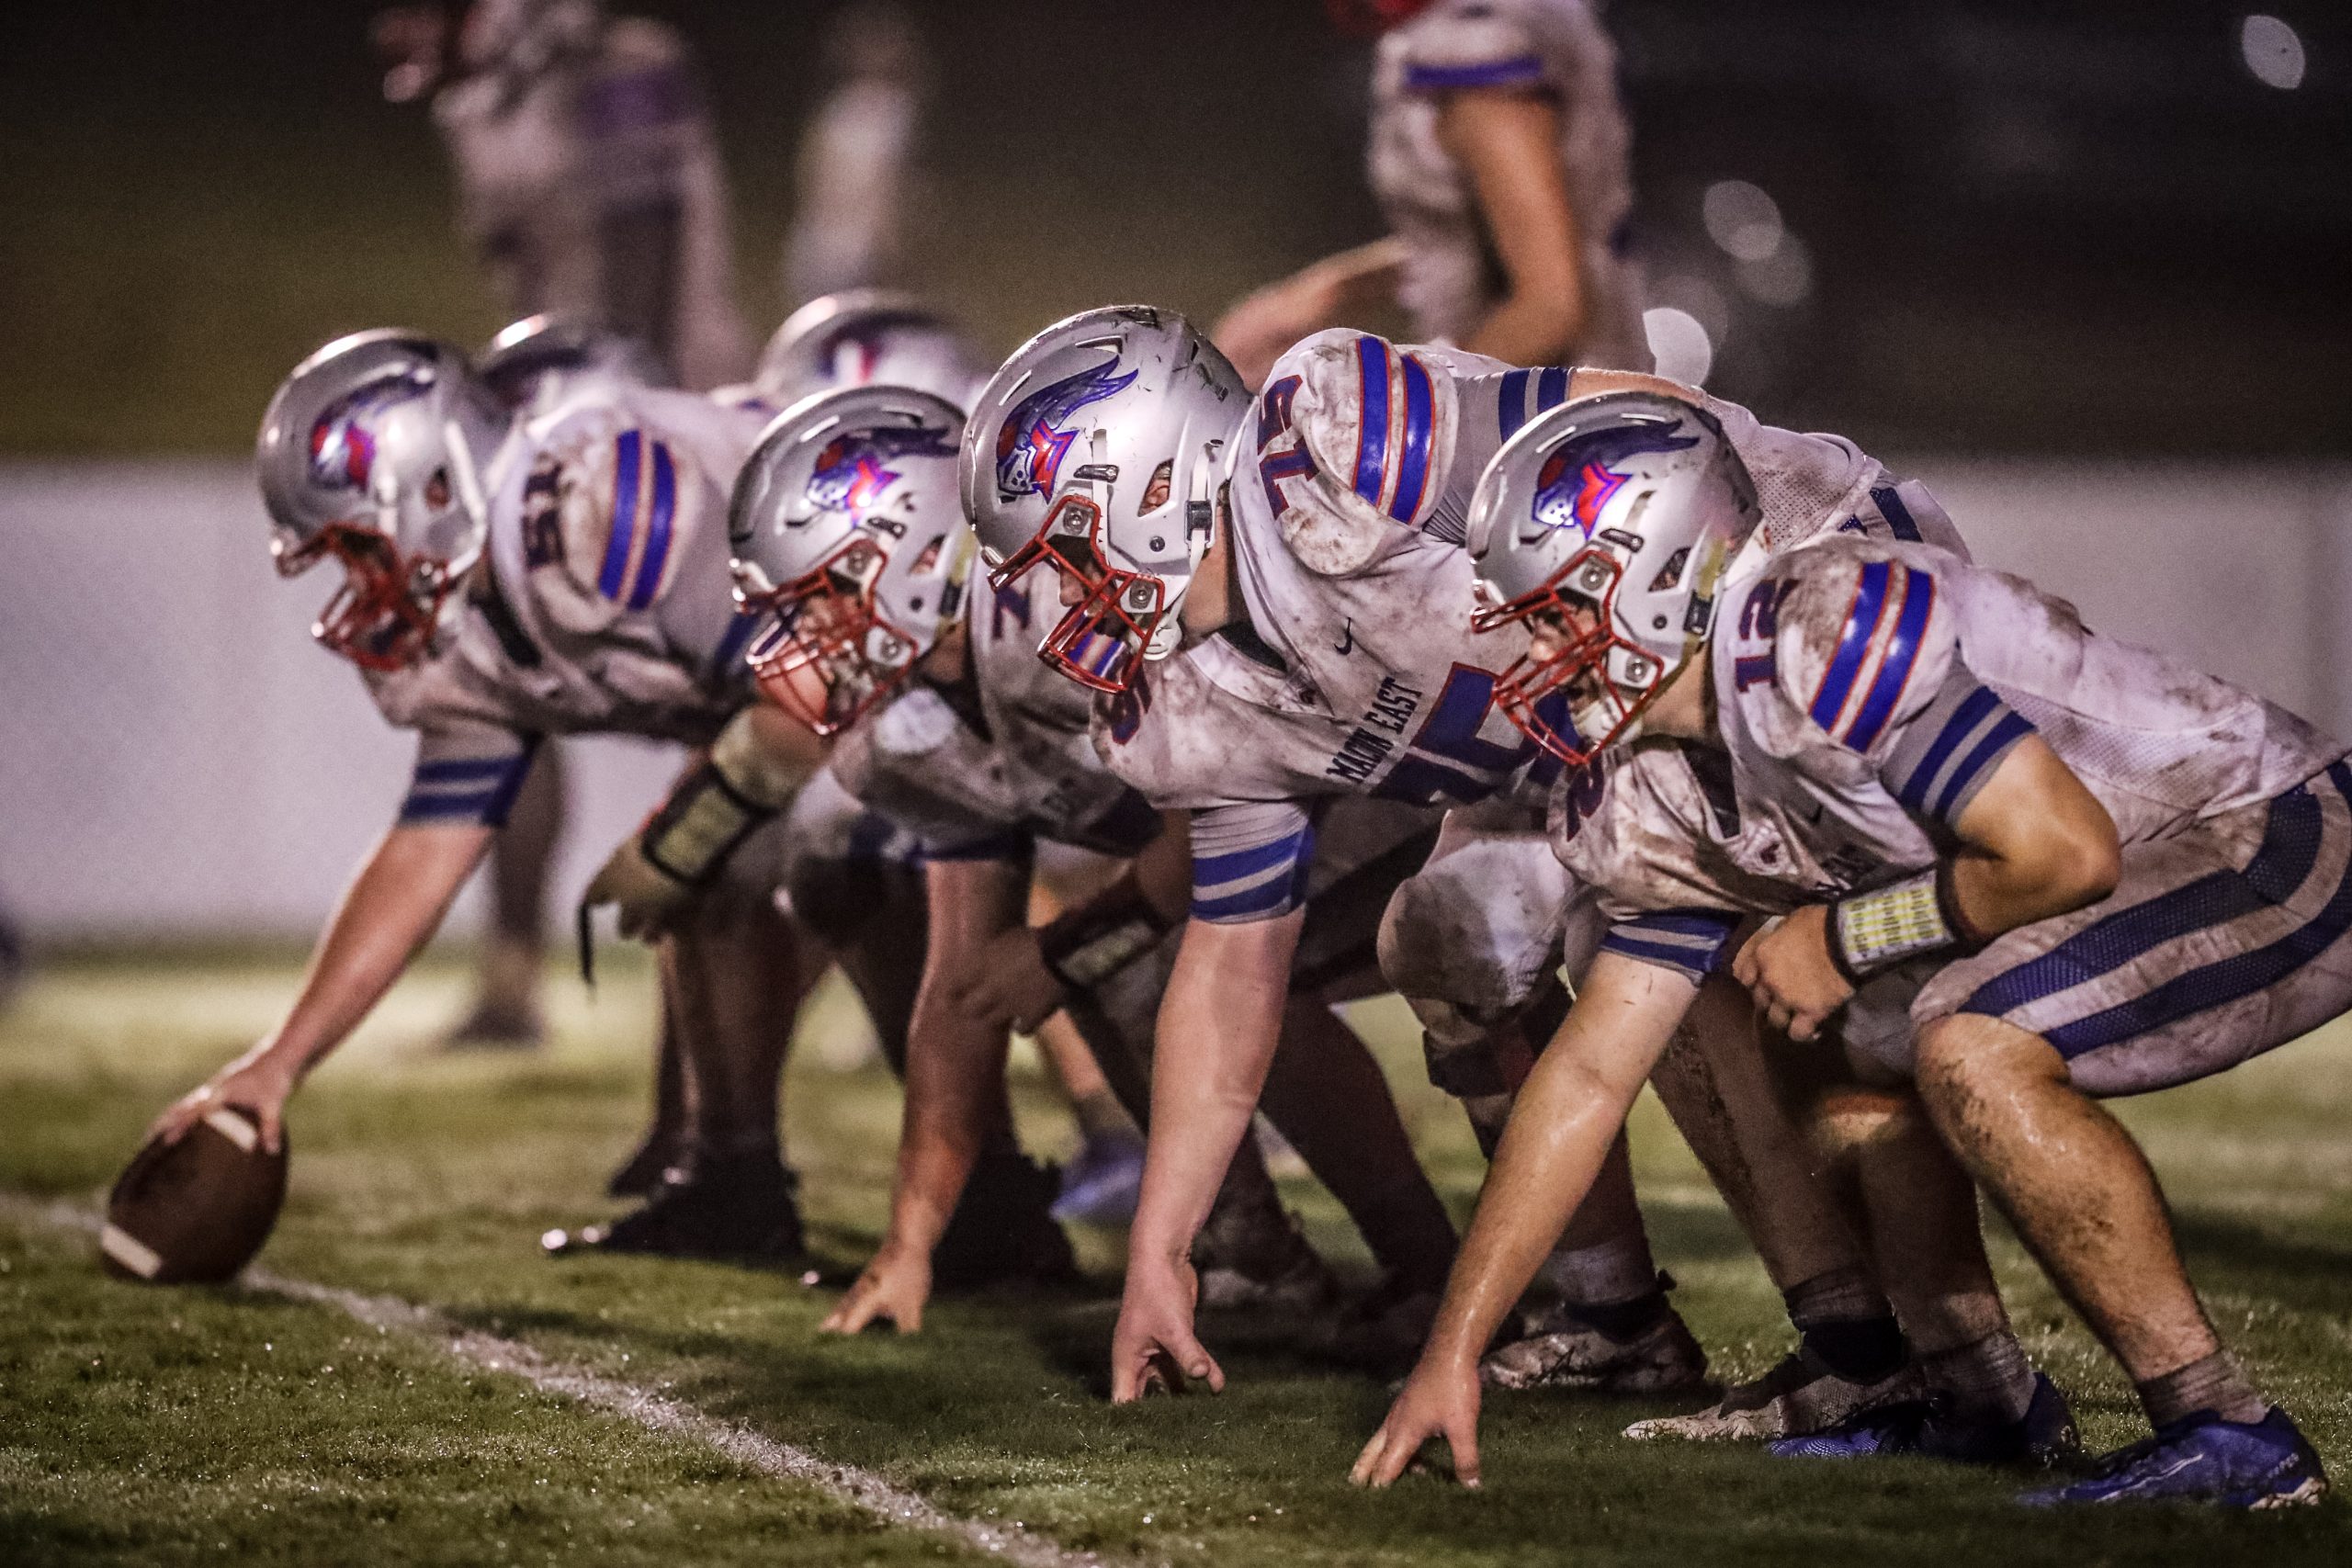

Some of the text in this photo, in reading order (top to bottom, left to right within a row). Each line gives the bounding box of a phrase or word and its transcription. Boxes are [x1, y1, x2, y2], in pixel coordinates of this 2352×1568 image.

[1258, 375, 1320, 520] 75
[1735, 578, 1801, 693] 12
[1326, 676, 1422, 784] MACON EAST
